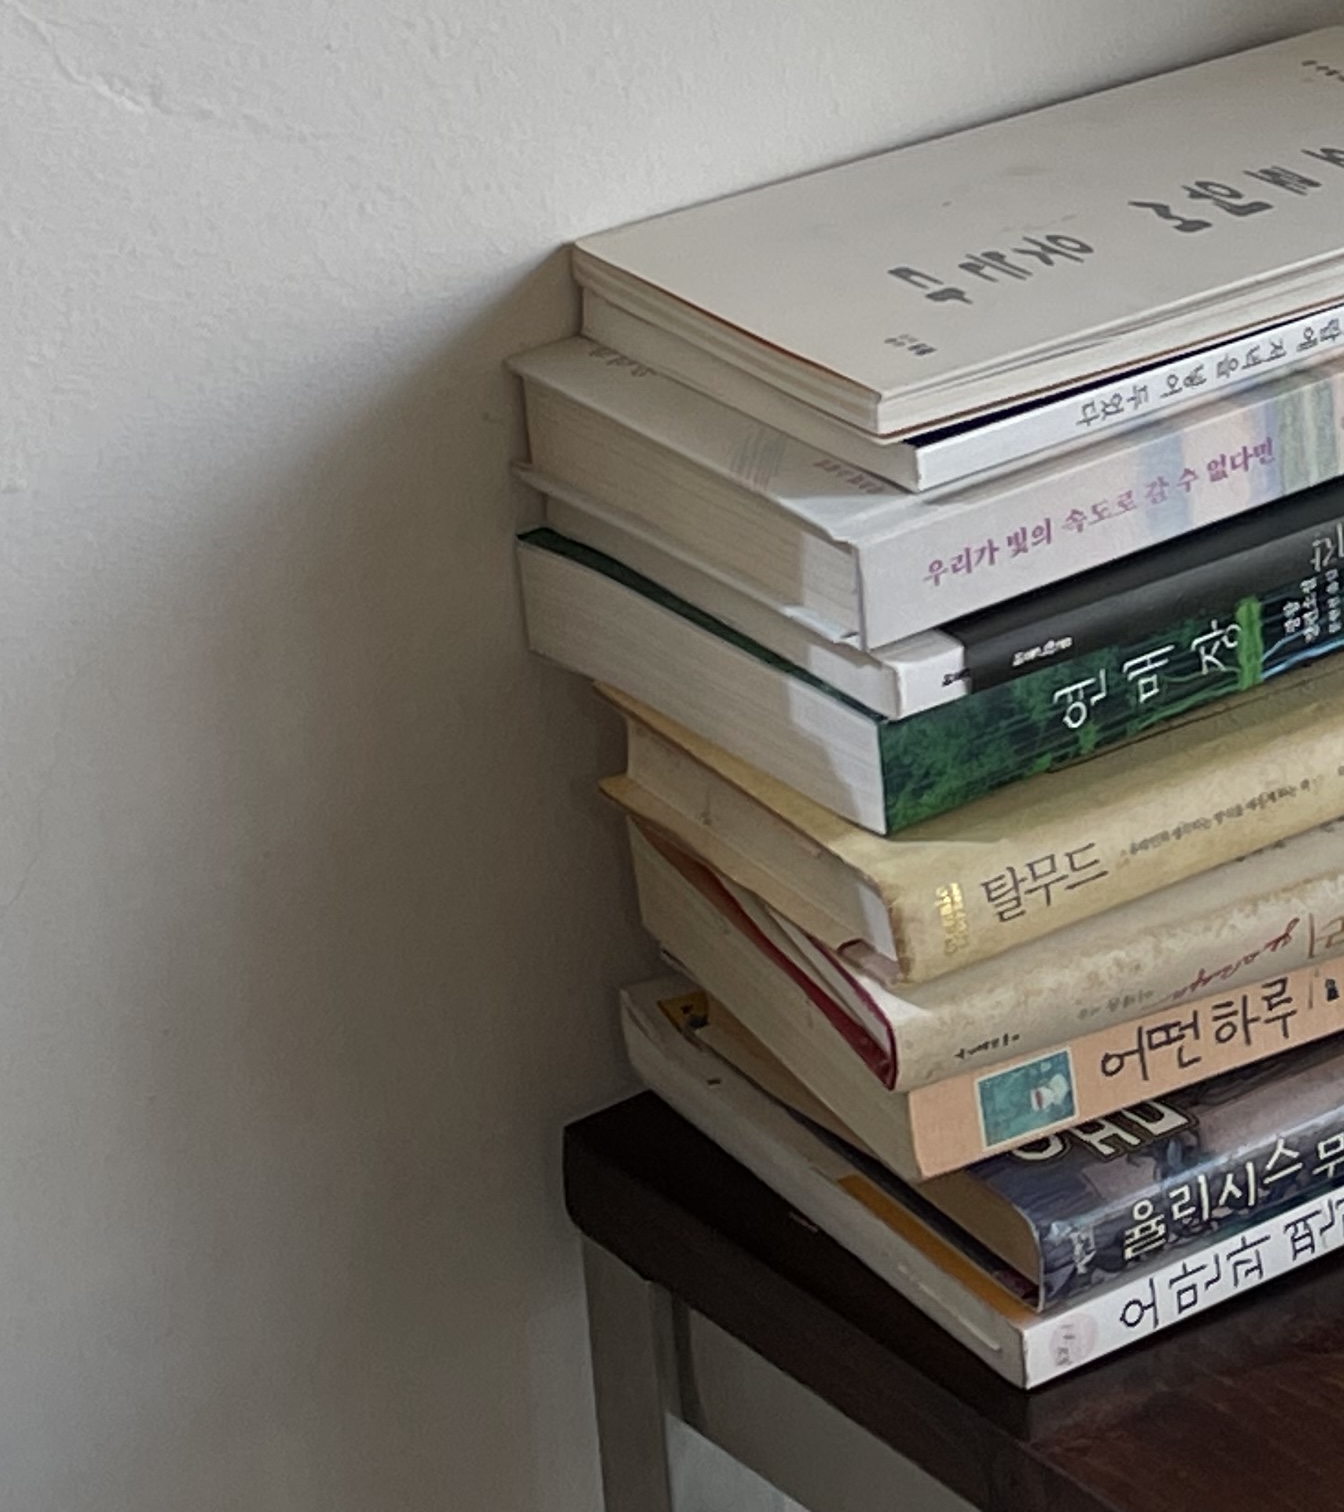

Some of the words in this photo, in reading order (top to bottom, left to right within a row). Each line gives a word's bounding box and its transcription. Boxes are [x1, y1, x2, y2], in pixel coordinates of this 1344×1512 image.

[1159, 364, 1207, 399] 넣어
[1216, 337, 1288, 379] 저녁을
[1076, 384, 1149, 427] 두었다
[923, 538, 1001, 587] 우리가
[1006, 517, 1053, 558] 빛의
[1061, 489, 1138, 533] 속도로
[1176, 467, 1199, 490] 수
[1205, 437, 1275, 483] 없다면
[1053, 619, 1242, 729] 연매장
[981, 842, 1109, 923] 탈무드
[1100, 1010, 1202, 1081] 어떤
[1211, 976, 1299, 1047] 하루
[1123, 1138, 1303, 1261] 율리시스
[1120, 1236, 1271, 1329] 오만과
